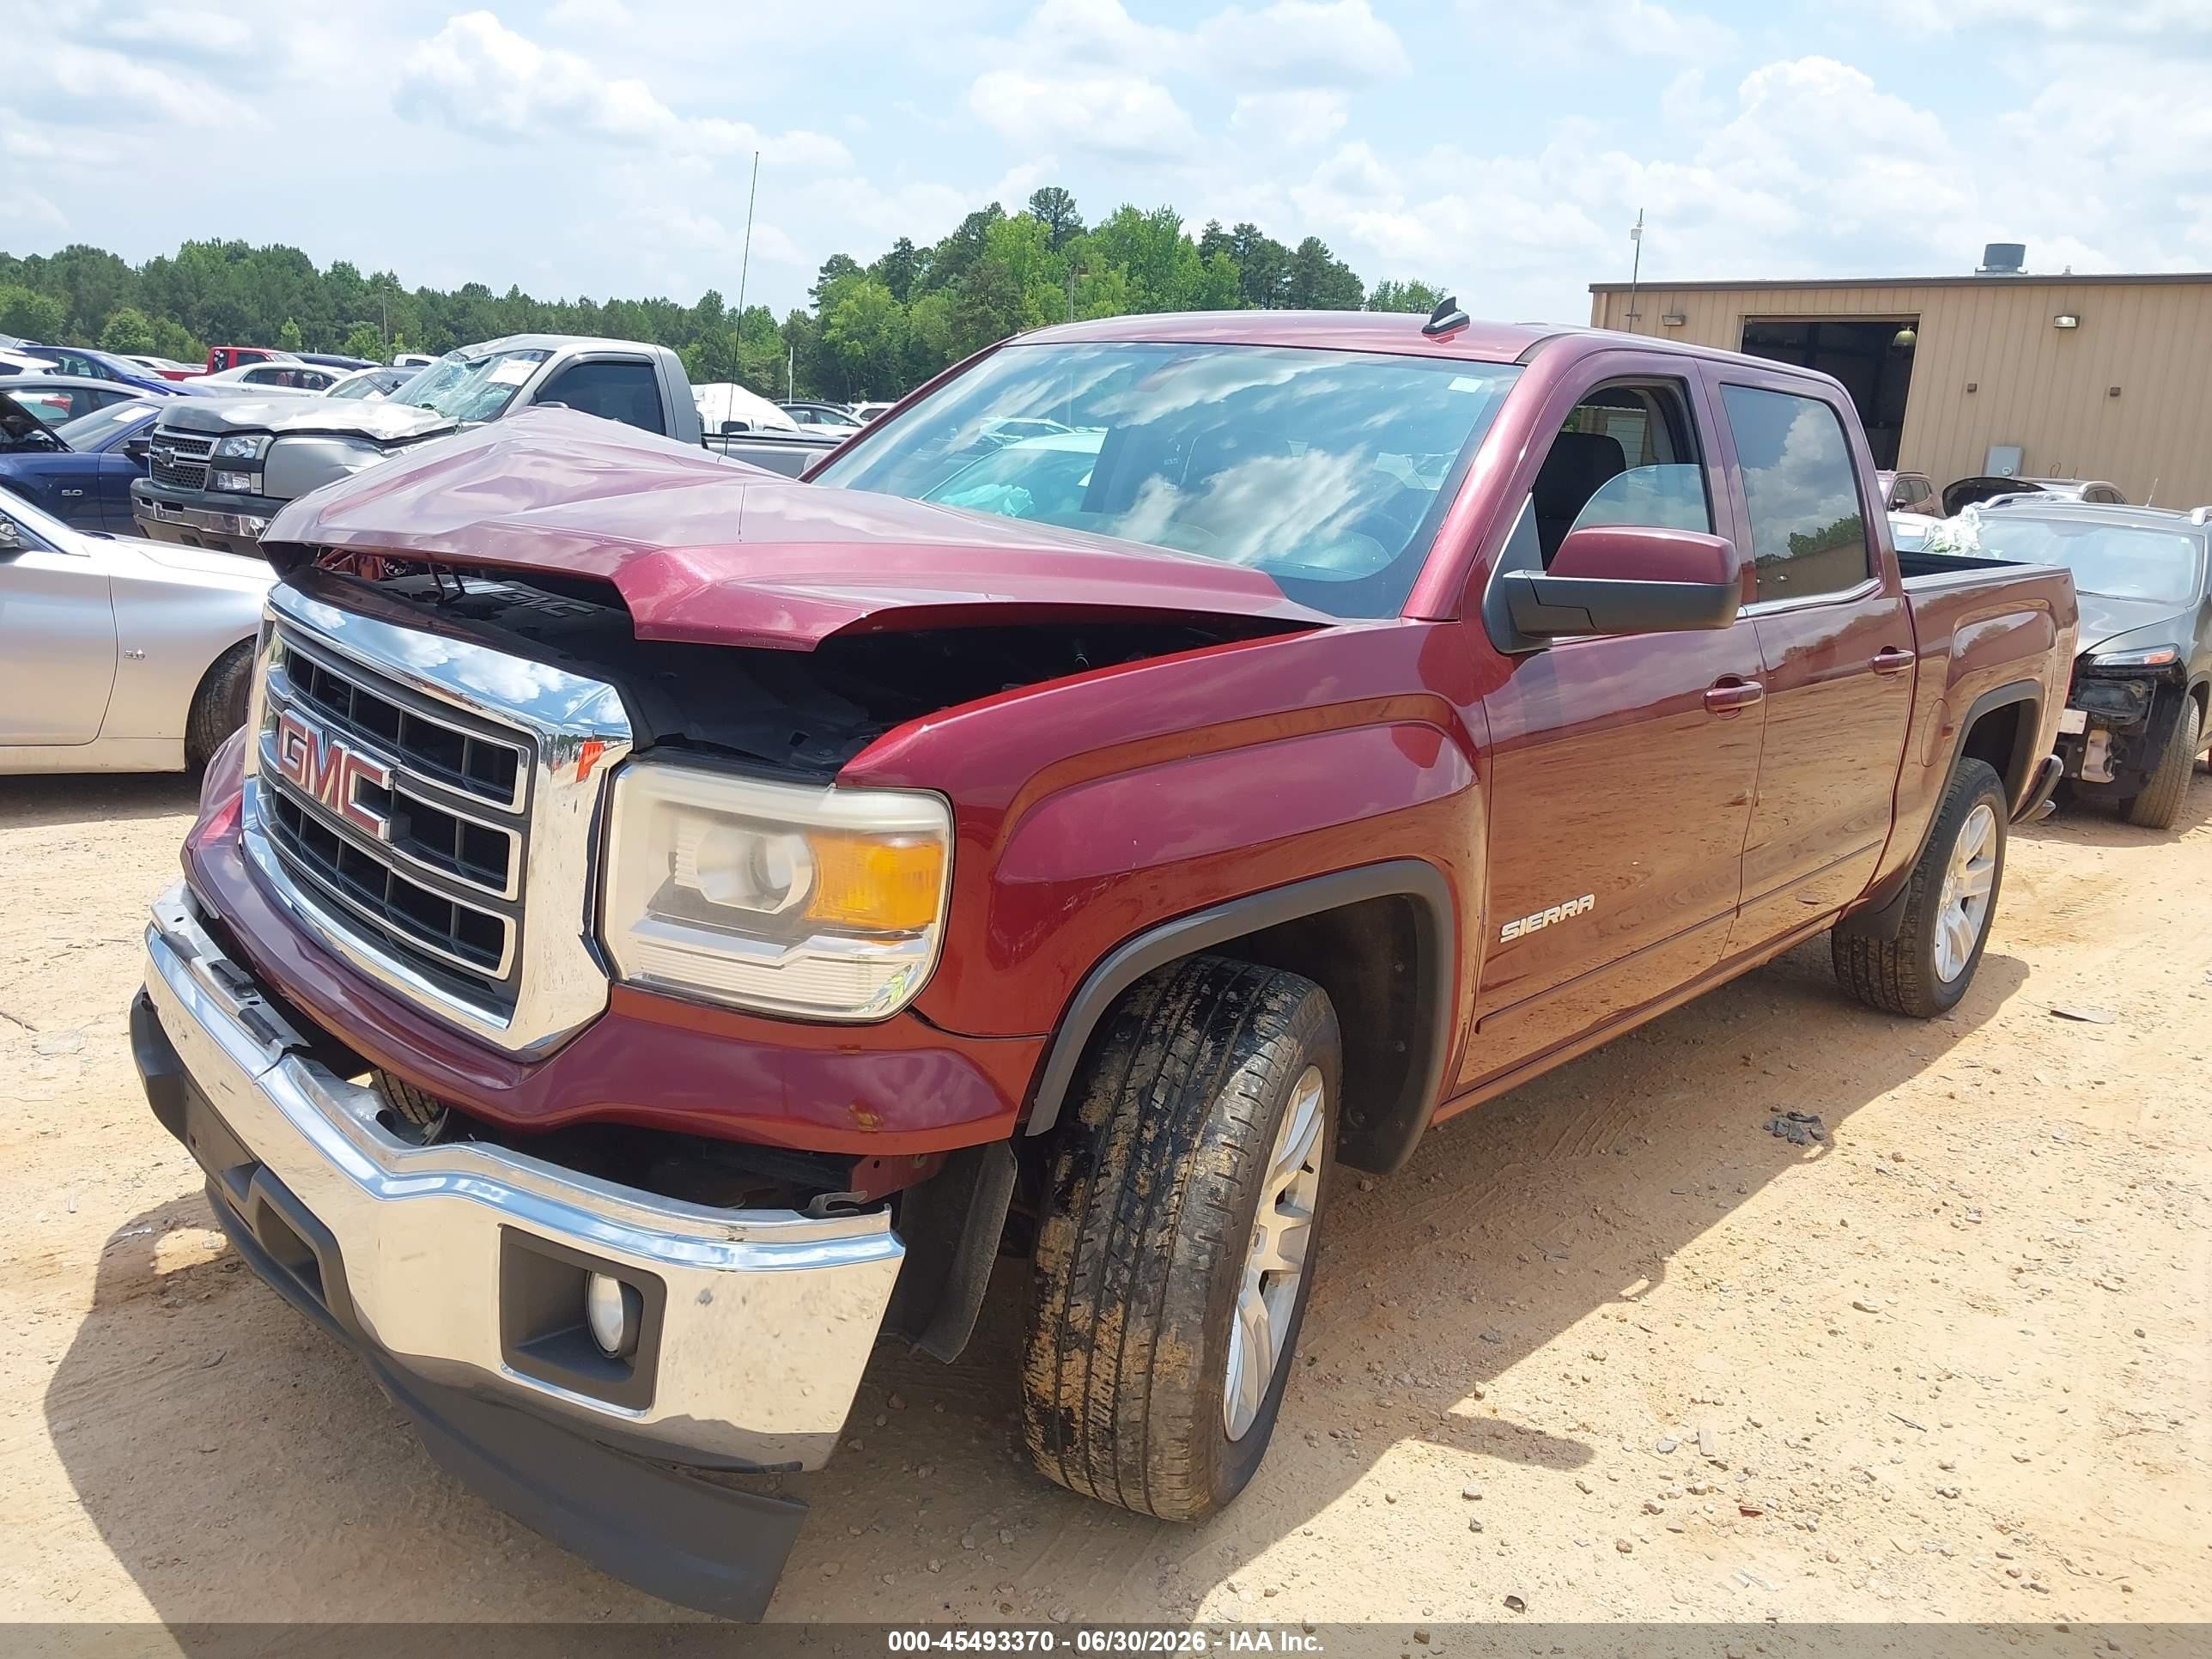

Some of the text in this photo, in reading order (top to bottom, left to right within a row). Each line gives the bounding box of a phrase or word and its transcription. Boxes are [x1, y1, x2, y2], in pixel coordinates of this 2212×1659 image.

[490, 590, 595, 617] GMC
[279, 708, 393, 841] GMC
[1499, 893, 1595, 944] SIERRA
